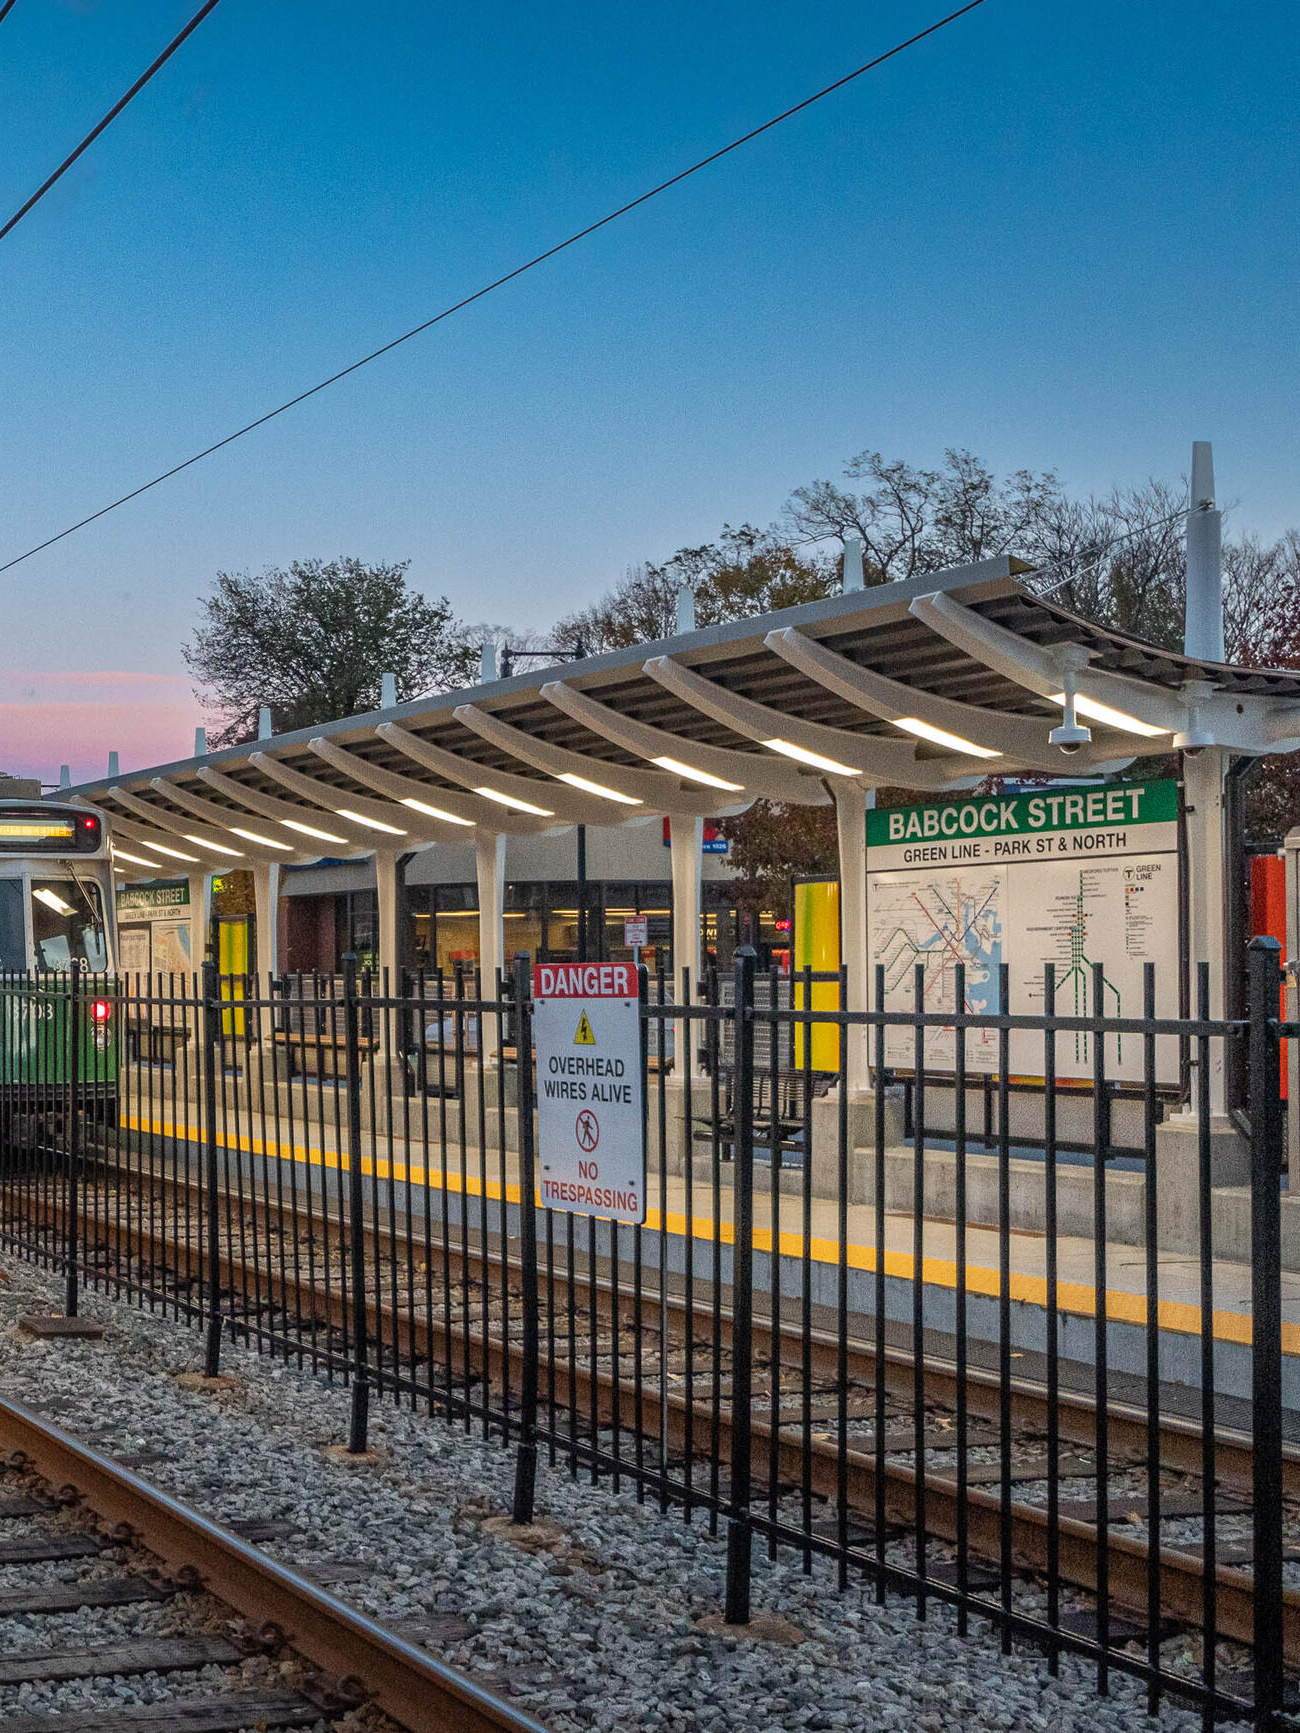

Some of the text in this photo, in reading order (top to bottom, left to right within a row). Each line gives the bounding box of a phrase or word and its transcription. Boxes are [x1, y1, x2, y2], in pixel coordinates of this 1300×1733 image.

[888, 788, 1145, 840] BABCOCK STREET
[903, 846, 947, 863] GREEN
[951, 843, 981, 859] LINE
[994, 839, 1032, 856] PARK
[1035, 837, 1054, 853] ST
[1058, 836, 1067, 850] &
[1072, 832, 1127, 850] NORTH
[1136, 864, 1162, 873] GREEN
[1136, 872, 1153, 881] LINE
[120, 888, 185, 907] BABCOCK STREET
[53, 957, 89, 973] 378
[540, 966, 628, 995] DANGER
[549, 1056, 625, 1078] OVERHEAD
[544, 1079, 632, 1104] WIRES ALIVE
[578, 1160, 598, 1181] NO
[543, 1179, 638, 1213] TRESPASSING
